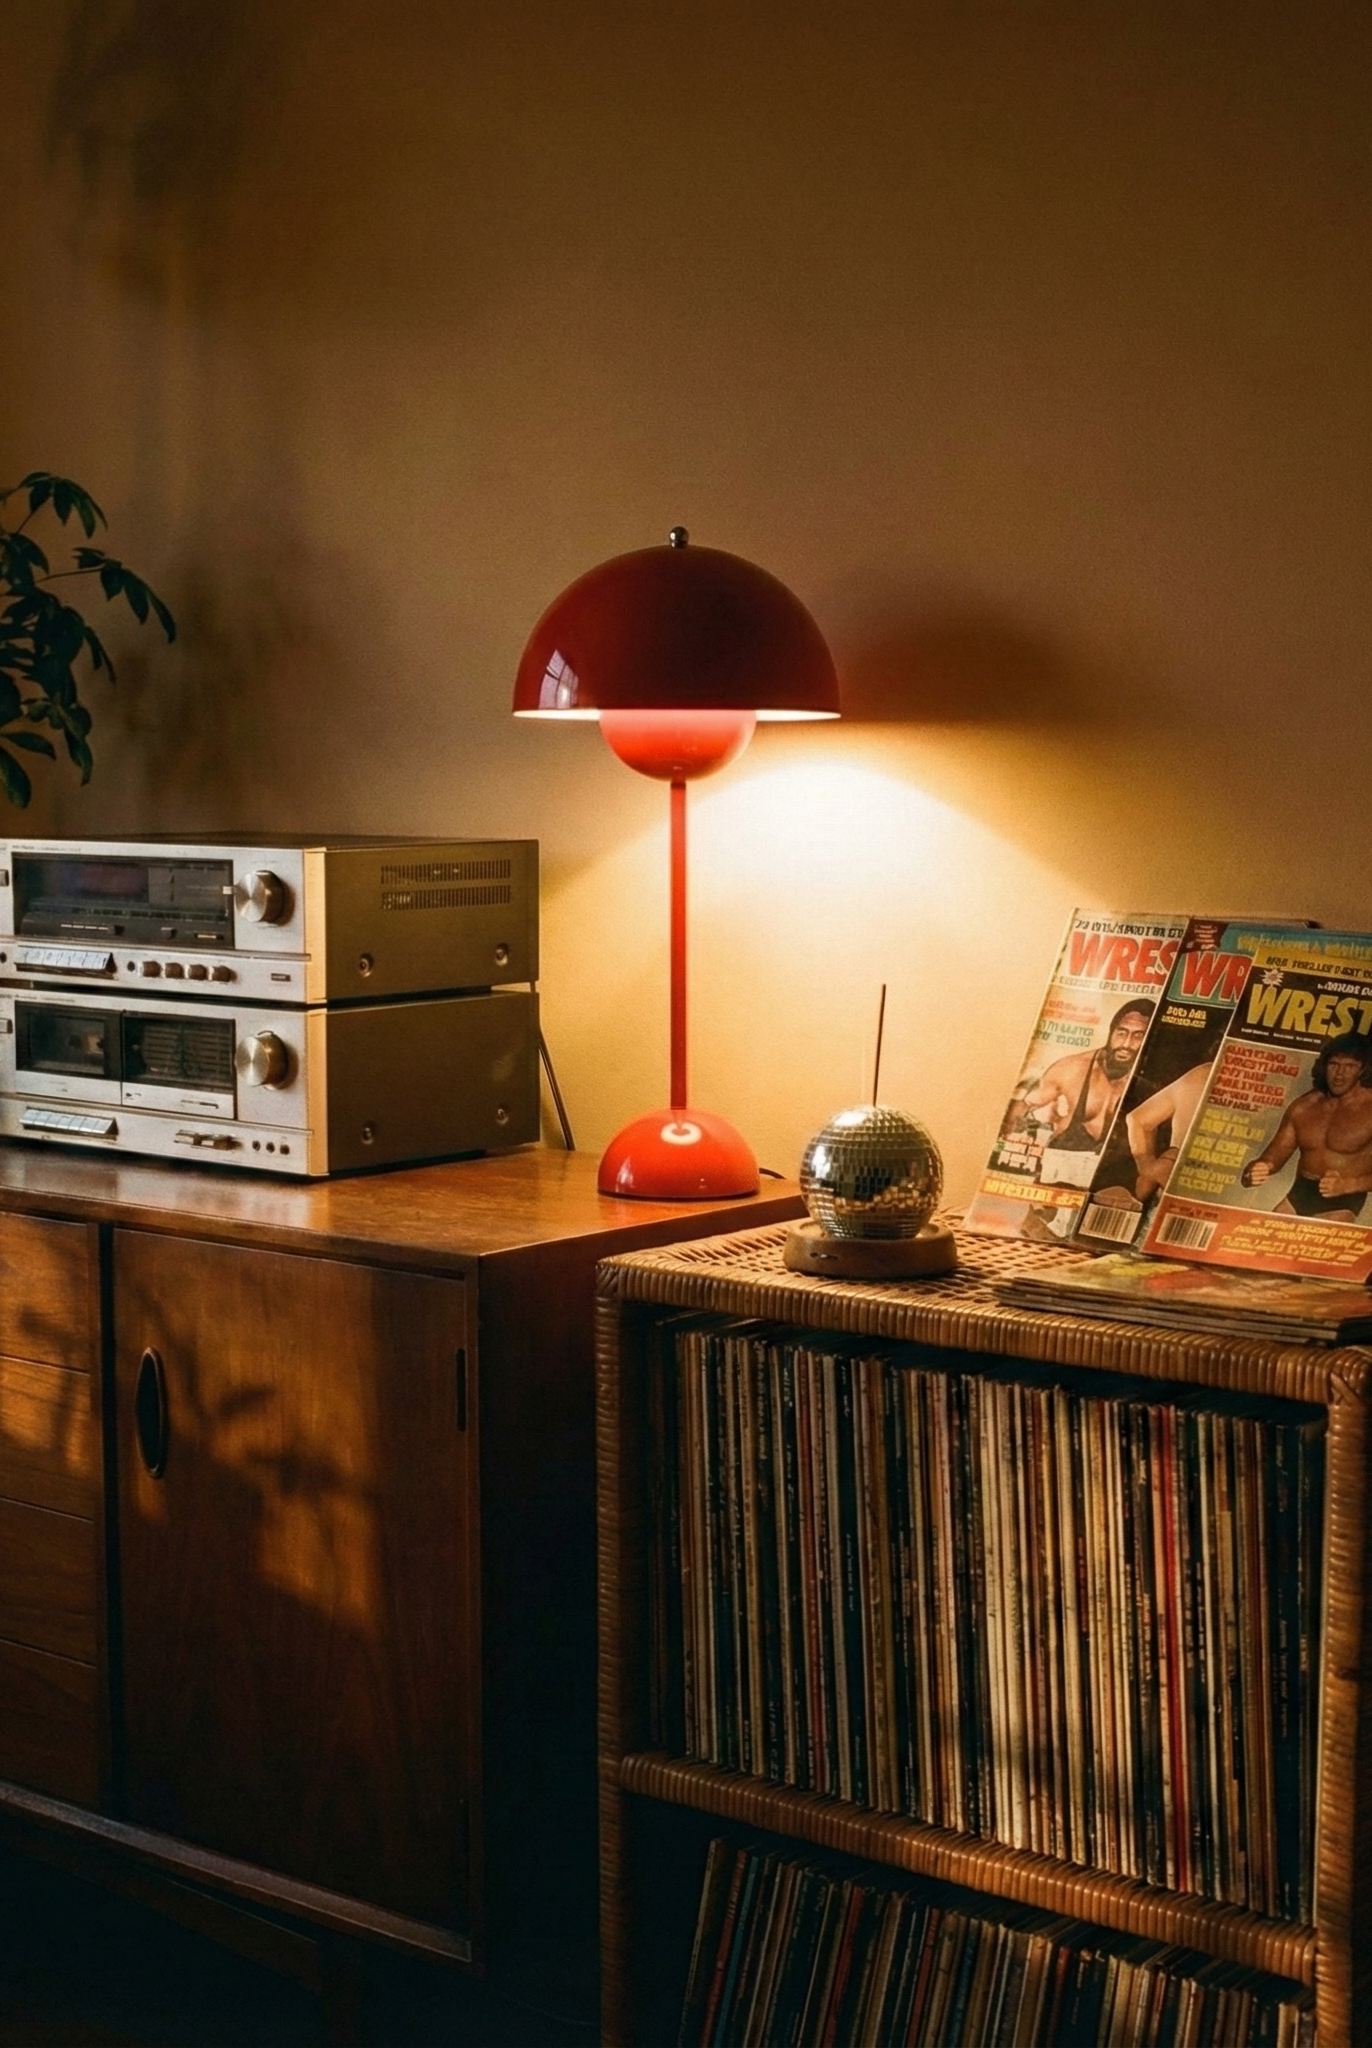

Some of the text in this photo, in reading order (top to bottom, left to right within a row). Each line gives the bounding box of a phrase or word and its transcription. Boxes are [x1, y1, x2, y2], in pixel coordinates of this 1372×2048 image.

[1069, 931, 1180, 988] WRES
[1181, 950, 1253, 1002] WR
[1246, 983, 1372, 1038] WREST
